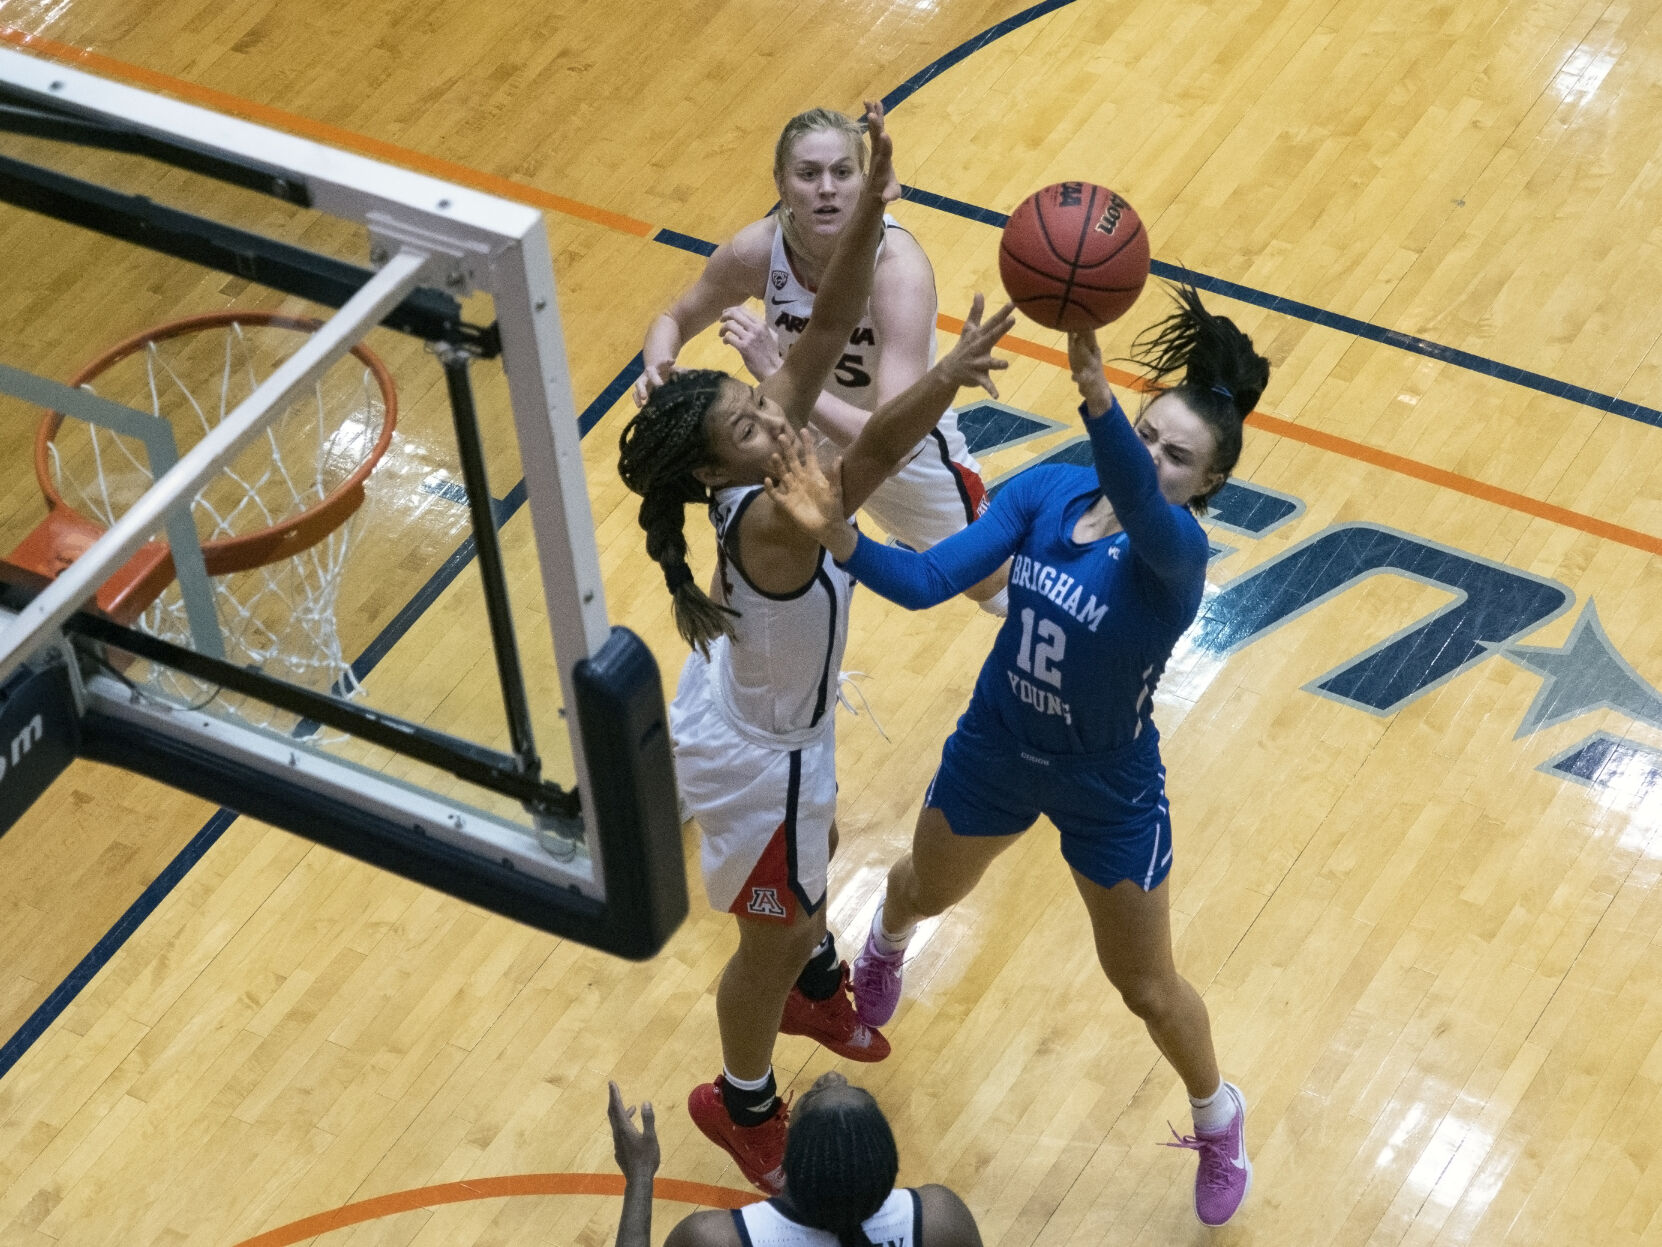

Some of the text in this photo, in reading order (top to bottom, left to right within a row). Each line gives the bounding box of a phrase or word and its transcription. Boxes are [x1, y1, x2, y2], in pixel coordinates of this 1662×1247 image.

[1012, 554, 1110, 633] BRIGHAM
[1017, 607, 1067, 690] 12
[747, 887, 787, 918] A
